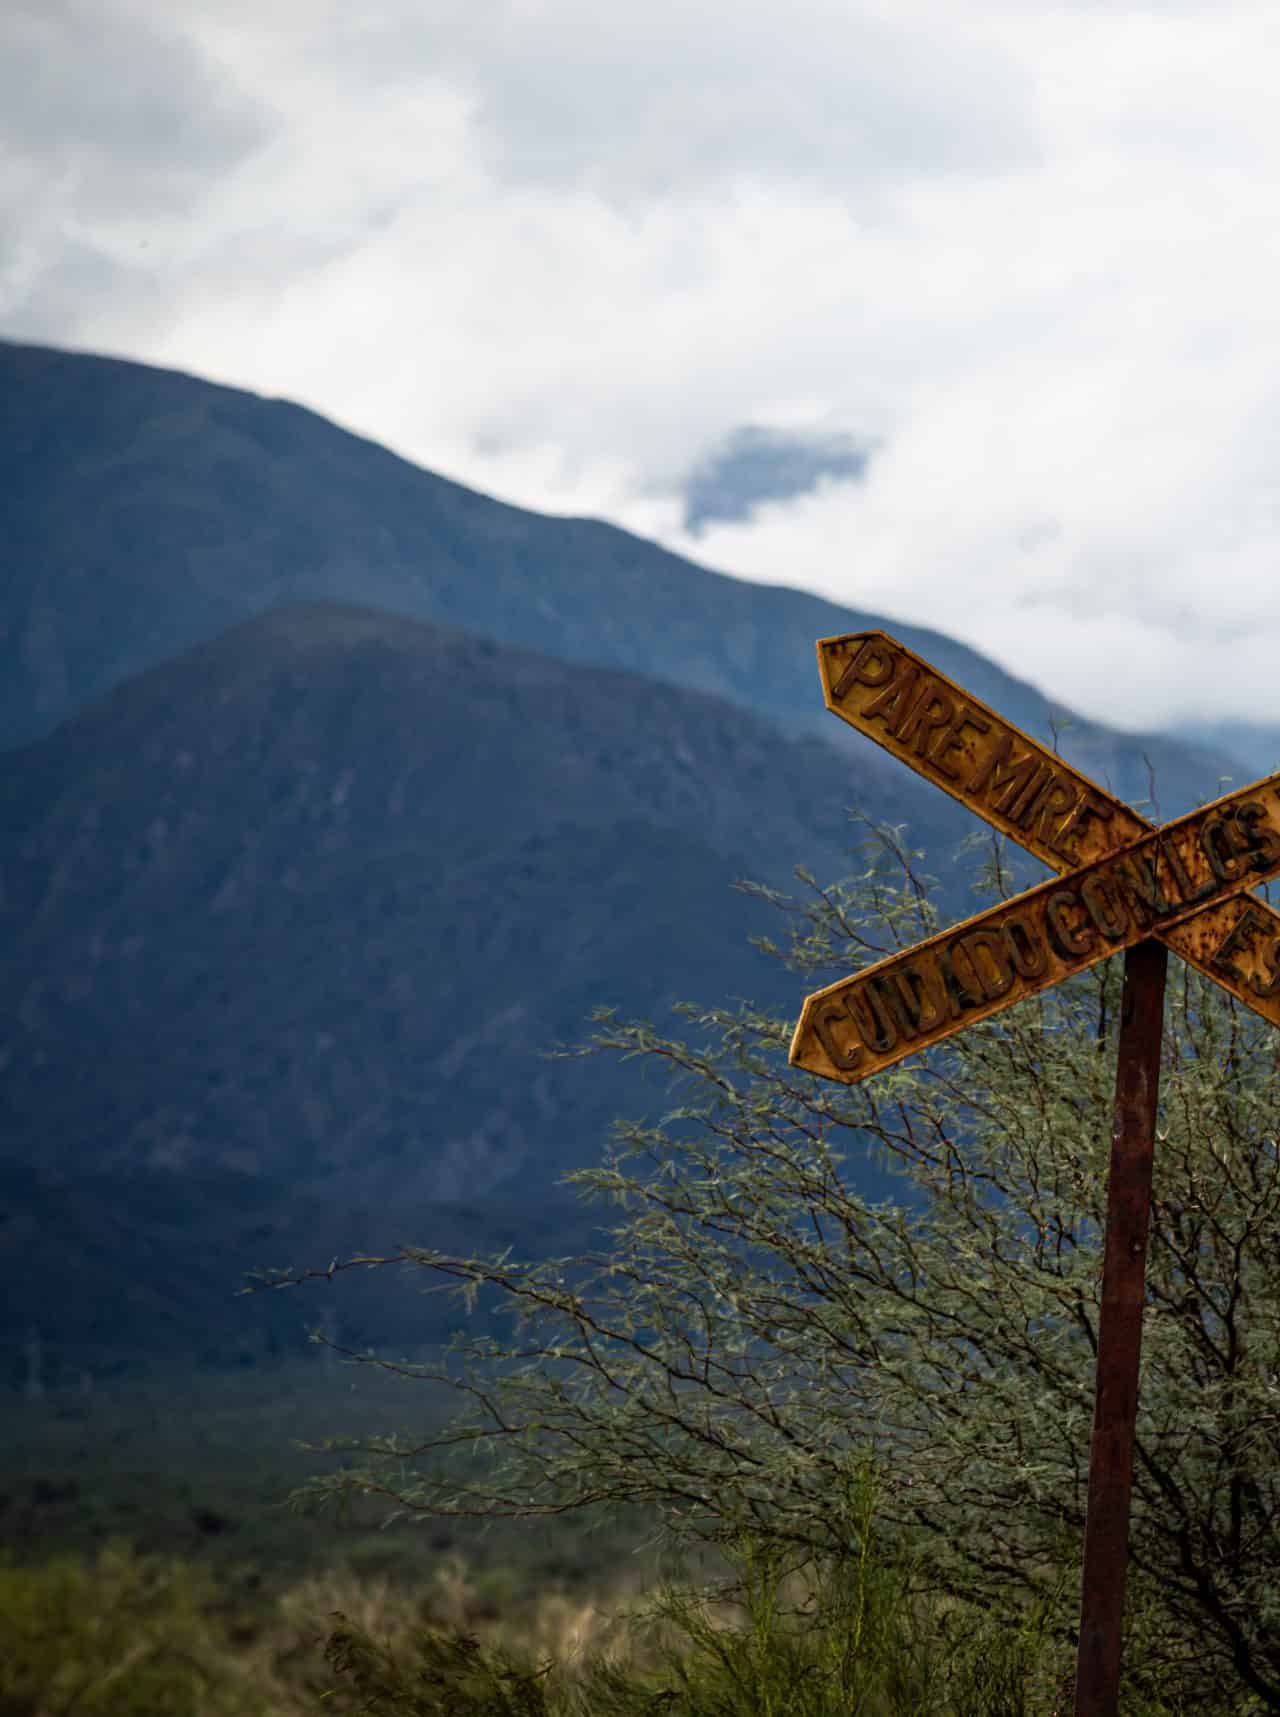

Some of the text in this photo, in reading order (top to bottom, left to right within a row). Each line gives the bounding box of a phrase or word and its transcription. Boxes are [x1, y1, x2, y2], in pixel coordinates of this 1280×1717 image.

[831, 640, 1117, 868] PARE MIRE
[812, 918, 1051, 1071] CUIDADO
[1046, 841, 1168, 963] CON
